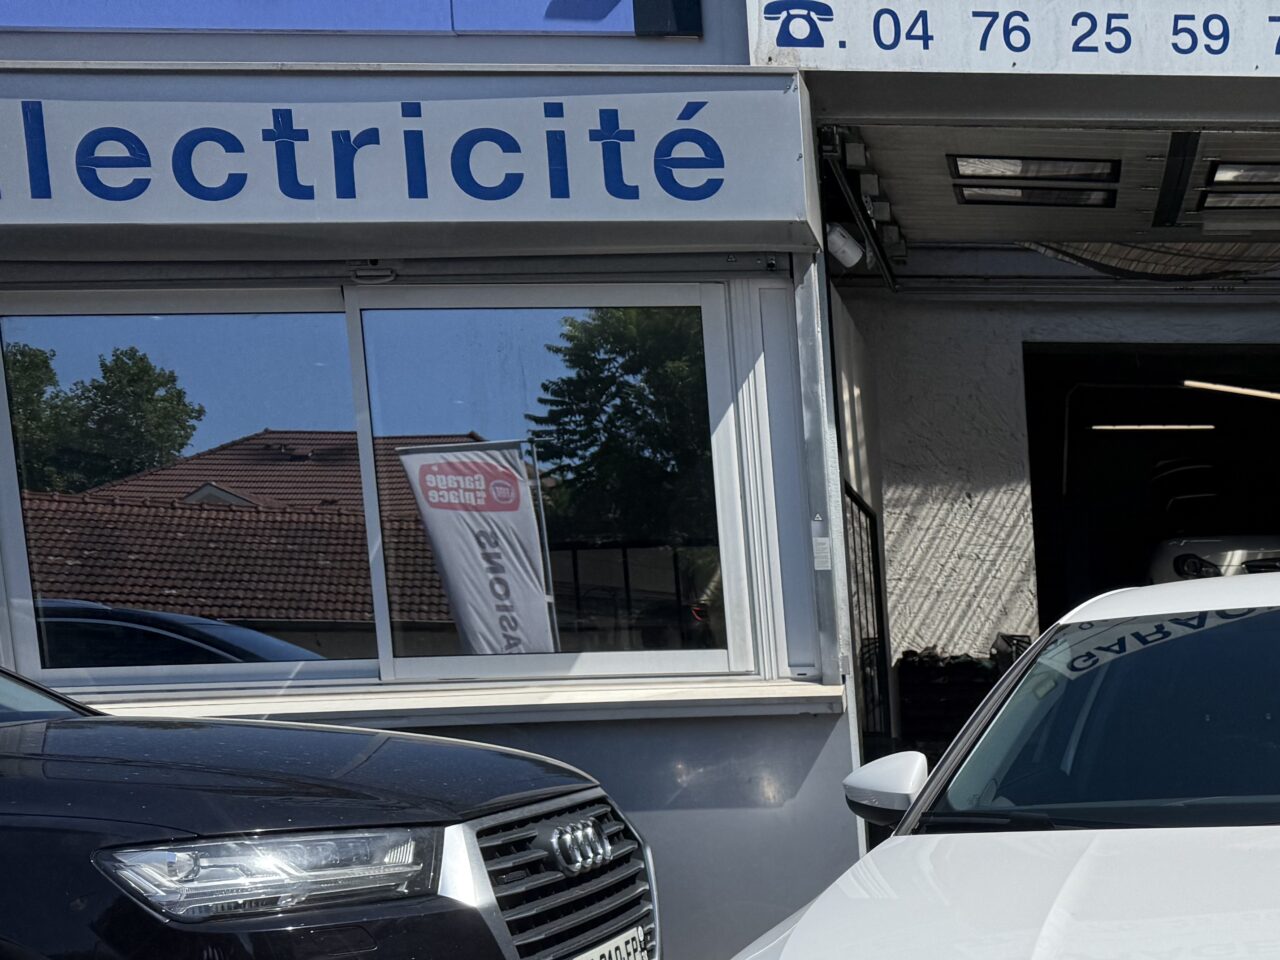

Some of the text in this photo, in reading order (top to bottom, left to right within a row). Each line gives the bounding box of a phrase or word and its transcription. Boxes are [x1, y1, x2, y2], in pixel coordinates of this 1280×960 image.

[872, 8, 935, 52] 04
[971, 10, 1032, 53] 76
[1071, 12, 1133, 54] 25
[1171, 13, 1231, 55] 59
[0, 100, 725, 201] lectricité
